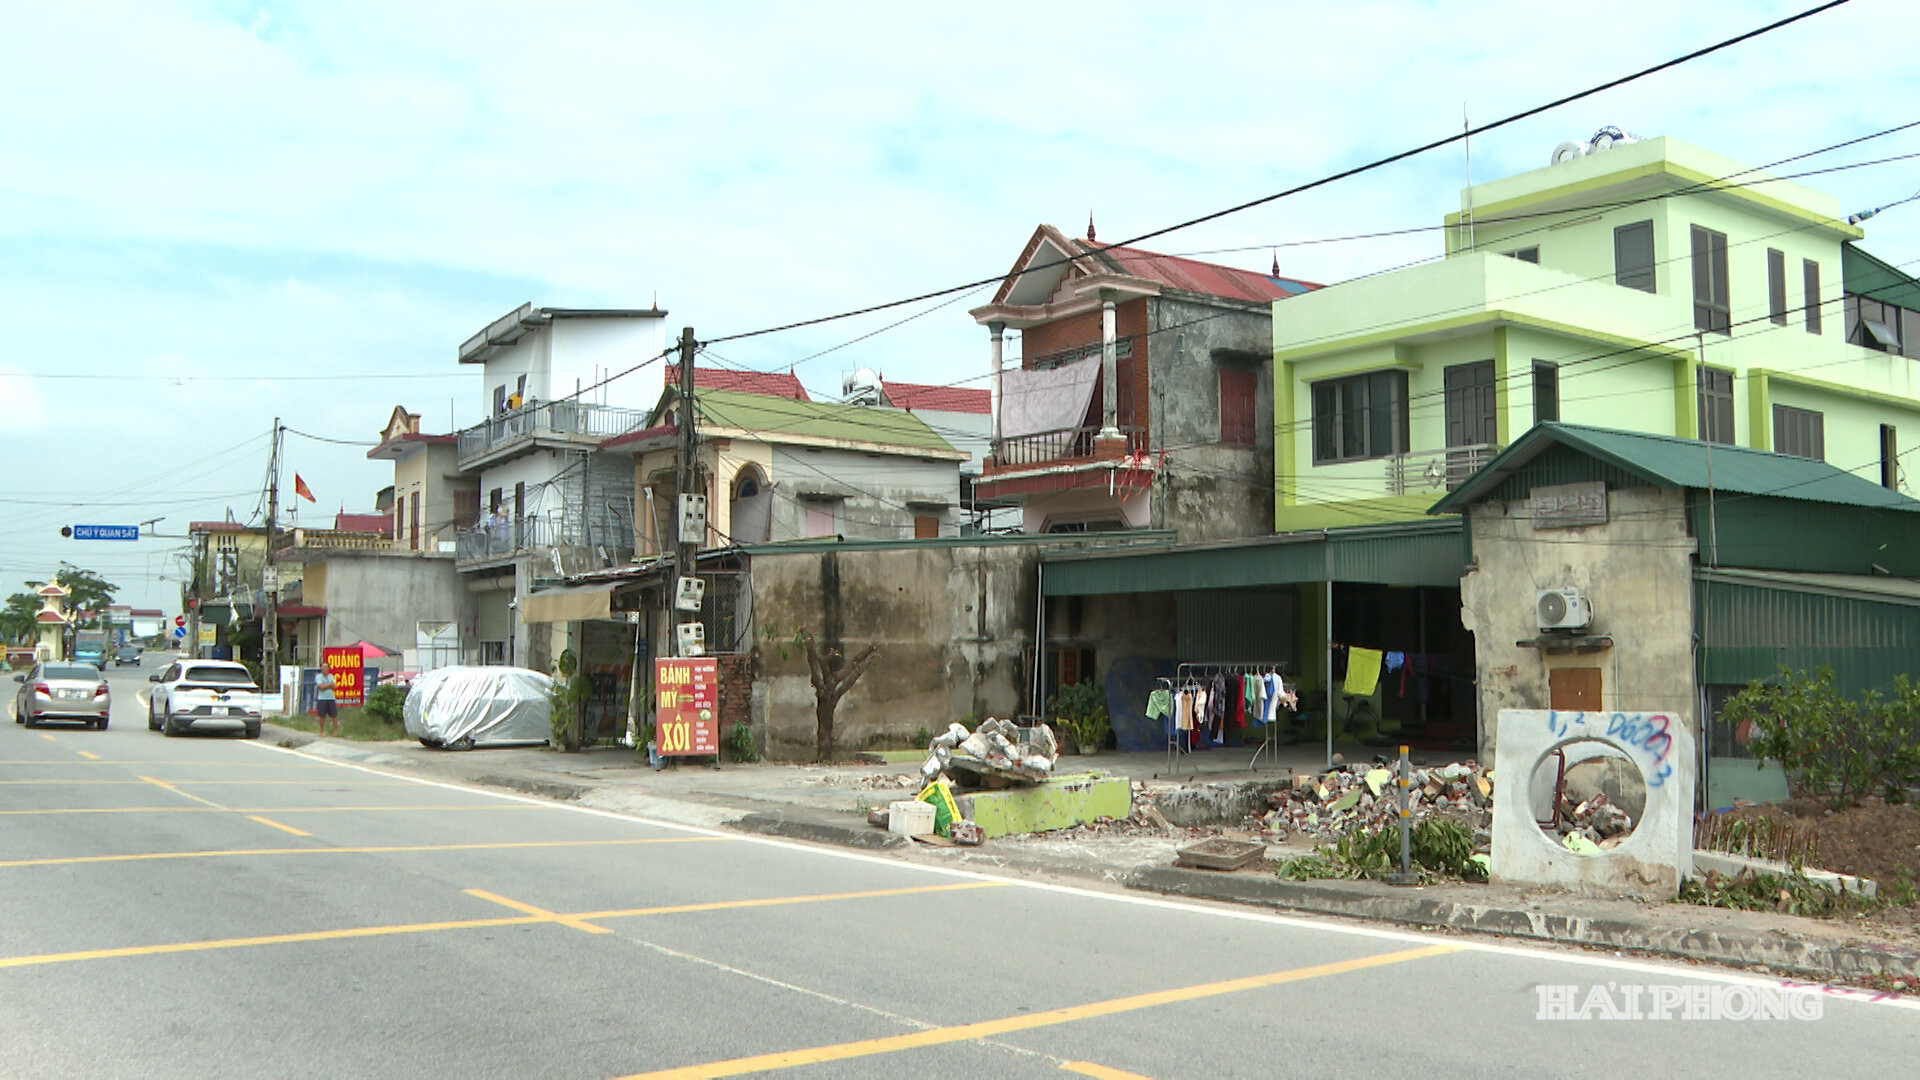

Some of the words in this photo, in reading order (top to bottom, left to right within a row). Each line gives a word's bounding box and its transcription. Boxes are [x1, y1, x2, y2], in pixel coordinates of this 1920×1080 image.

[100, 528, 120, 537] QUAN
[334, 670, 355, 687] CÁO
[660, 663, 690, 684] BÁNH
[662, 713, 690, 751] XÔI
